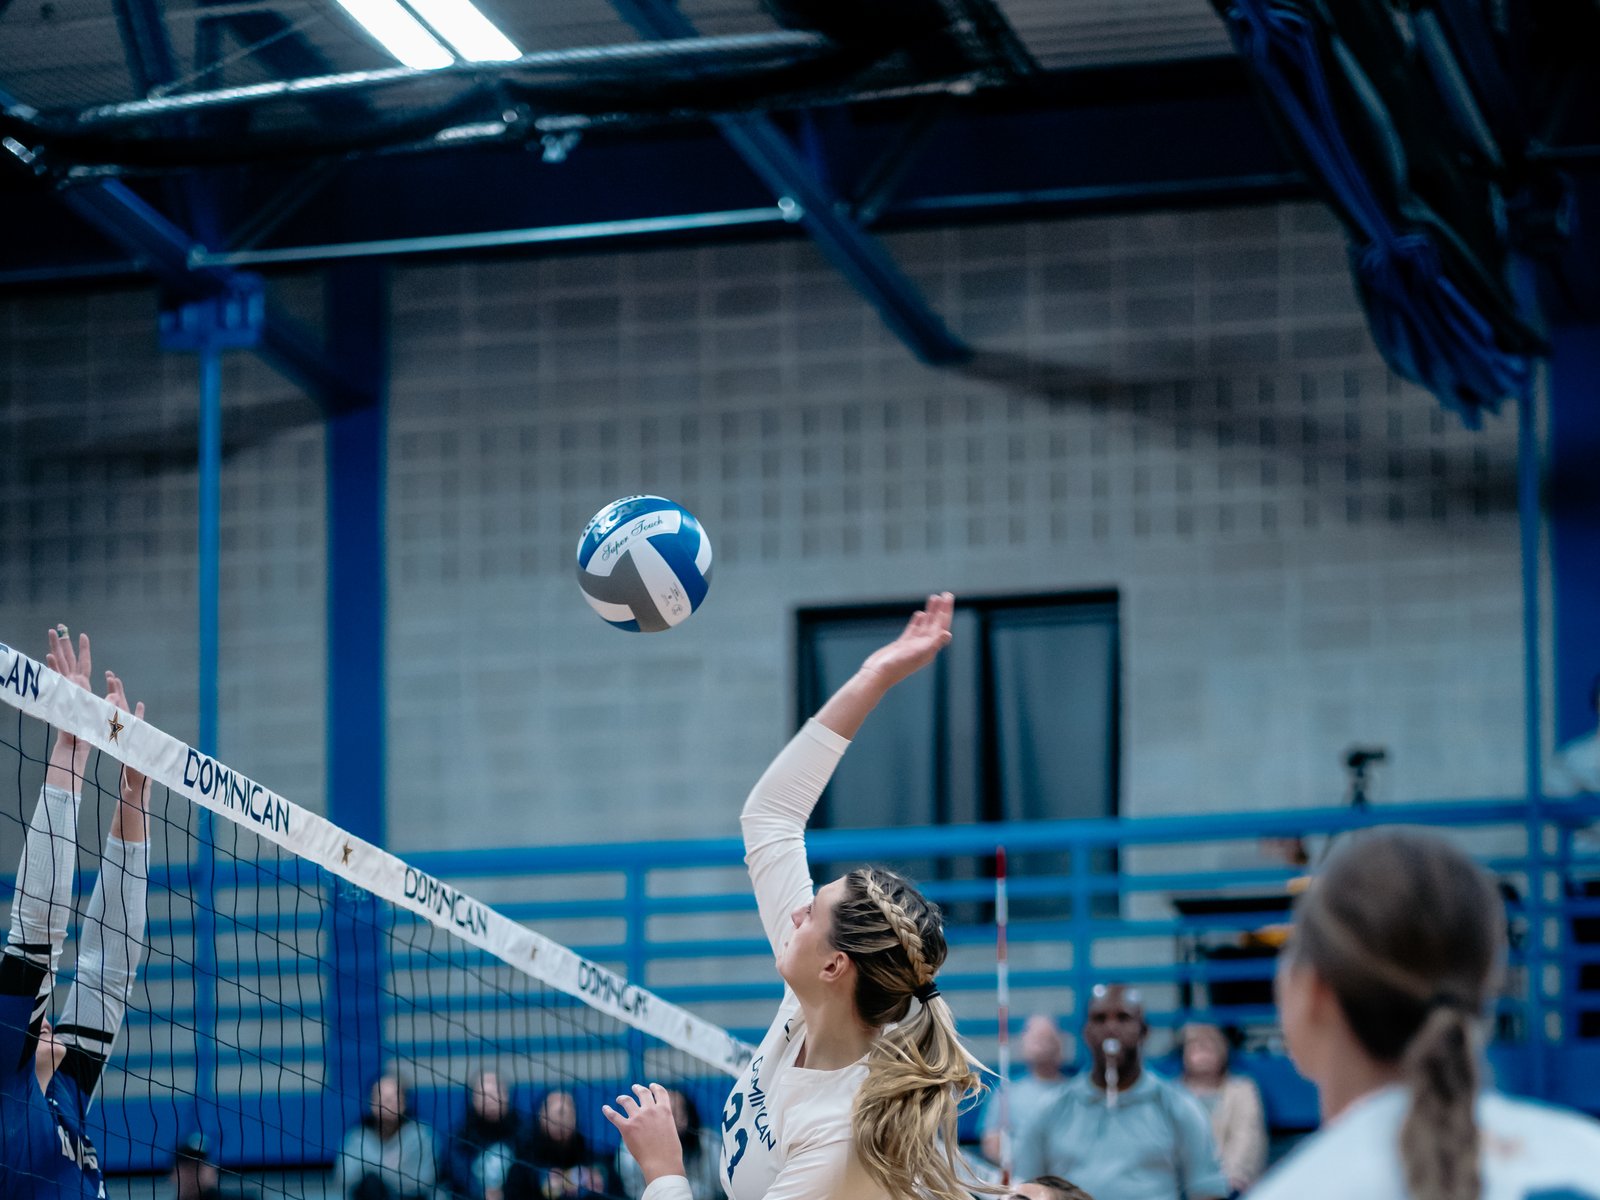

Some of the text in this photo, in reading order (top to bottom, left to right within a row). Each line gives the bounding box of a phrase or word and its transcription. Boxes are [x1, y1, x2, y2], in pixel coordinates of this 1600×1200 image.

[602, 515, 664, 561] Super Touch
[183, 748, 290, 835] DOMINICAN
